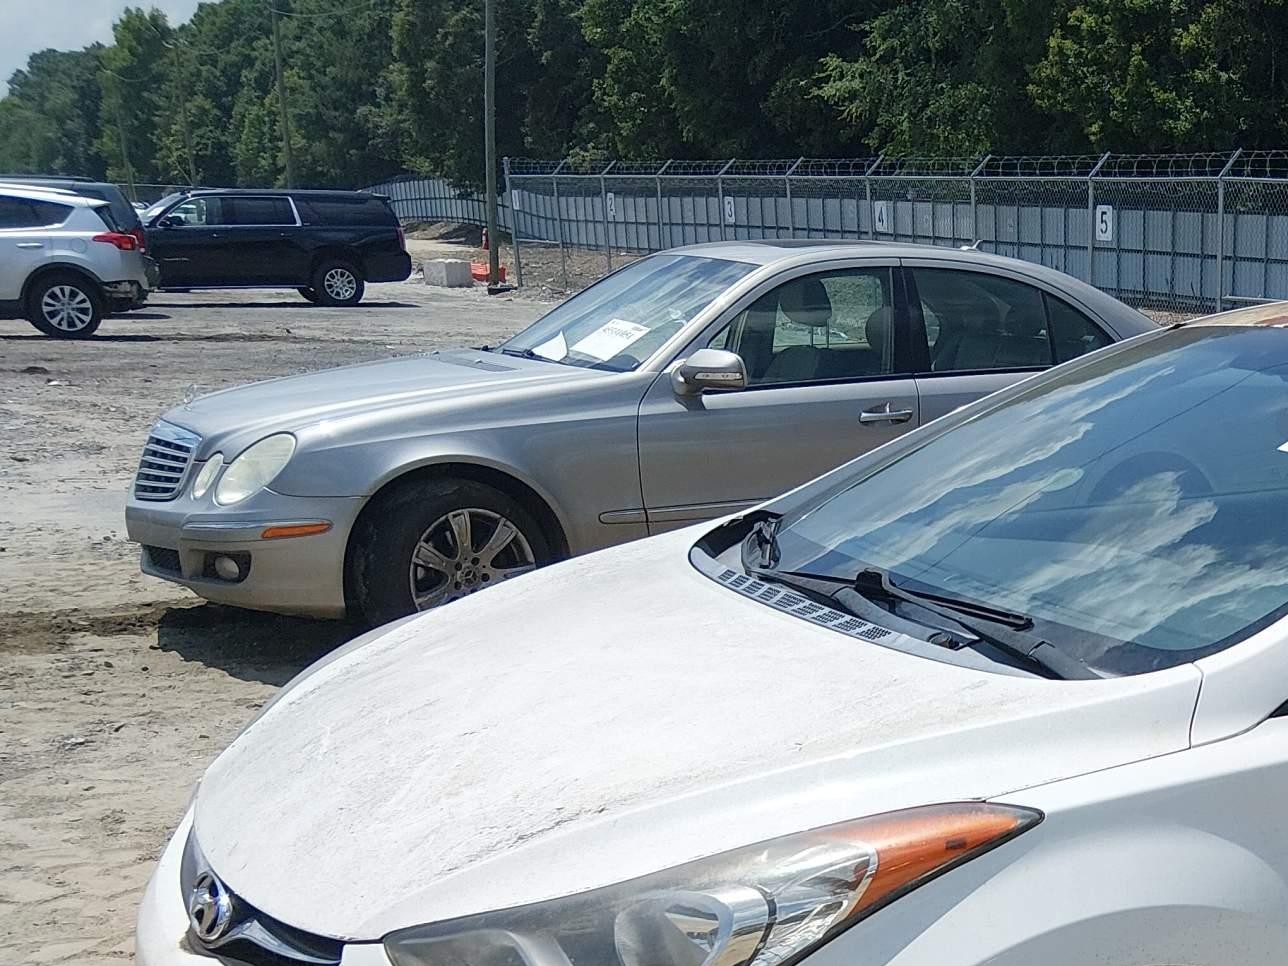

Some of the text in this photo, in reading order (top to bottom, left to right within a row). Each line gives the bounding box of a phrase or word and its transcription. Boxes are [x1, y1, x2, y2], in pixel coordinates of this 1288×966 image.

[727, 201, 733, 218] 3
[878, 206, 885, 227] 4
[1100, 211, 1108, 234] 5
